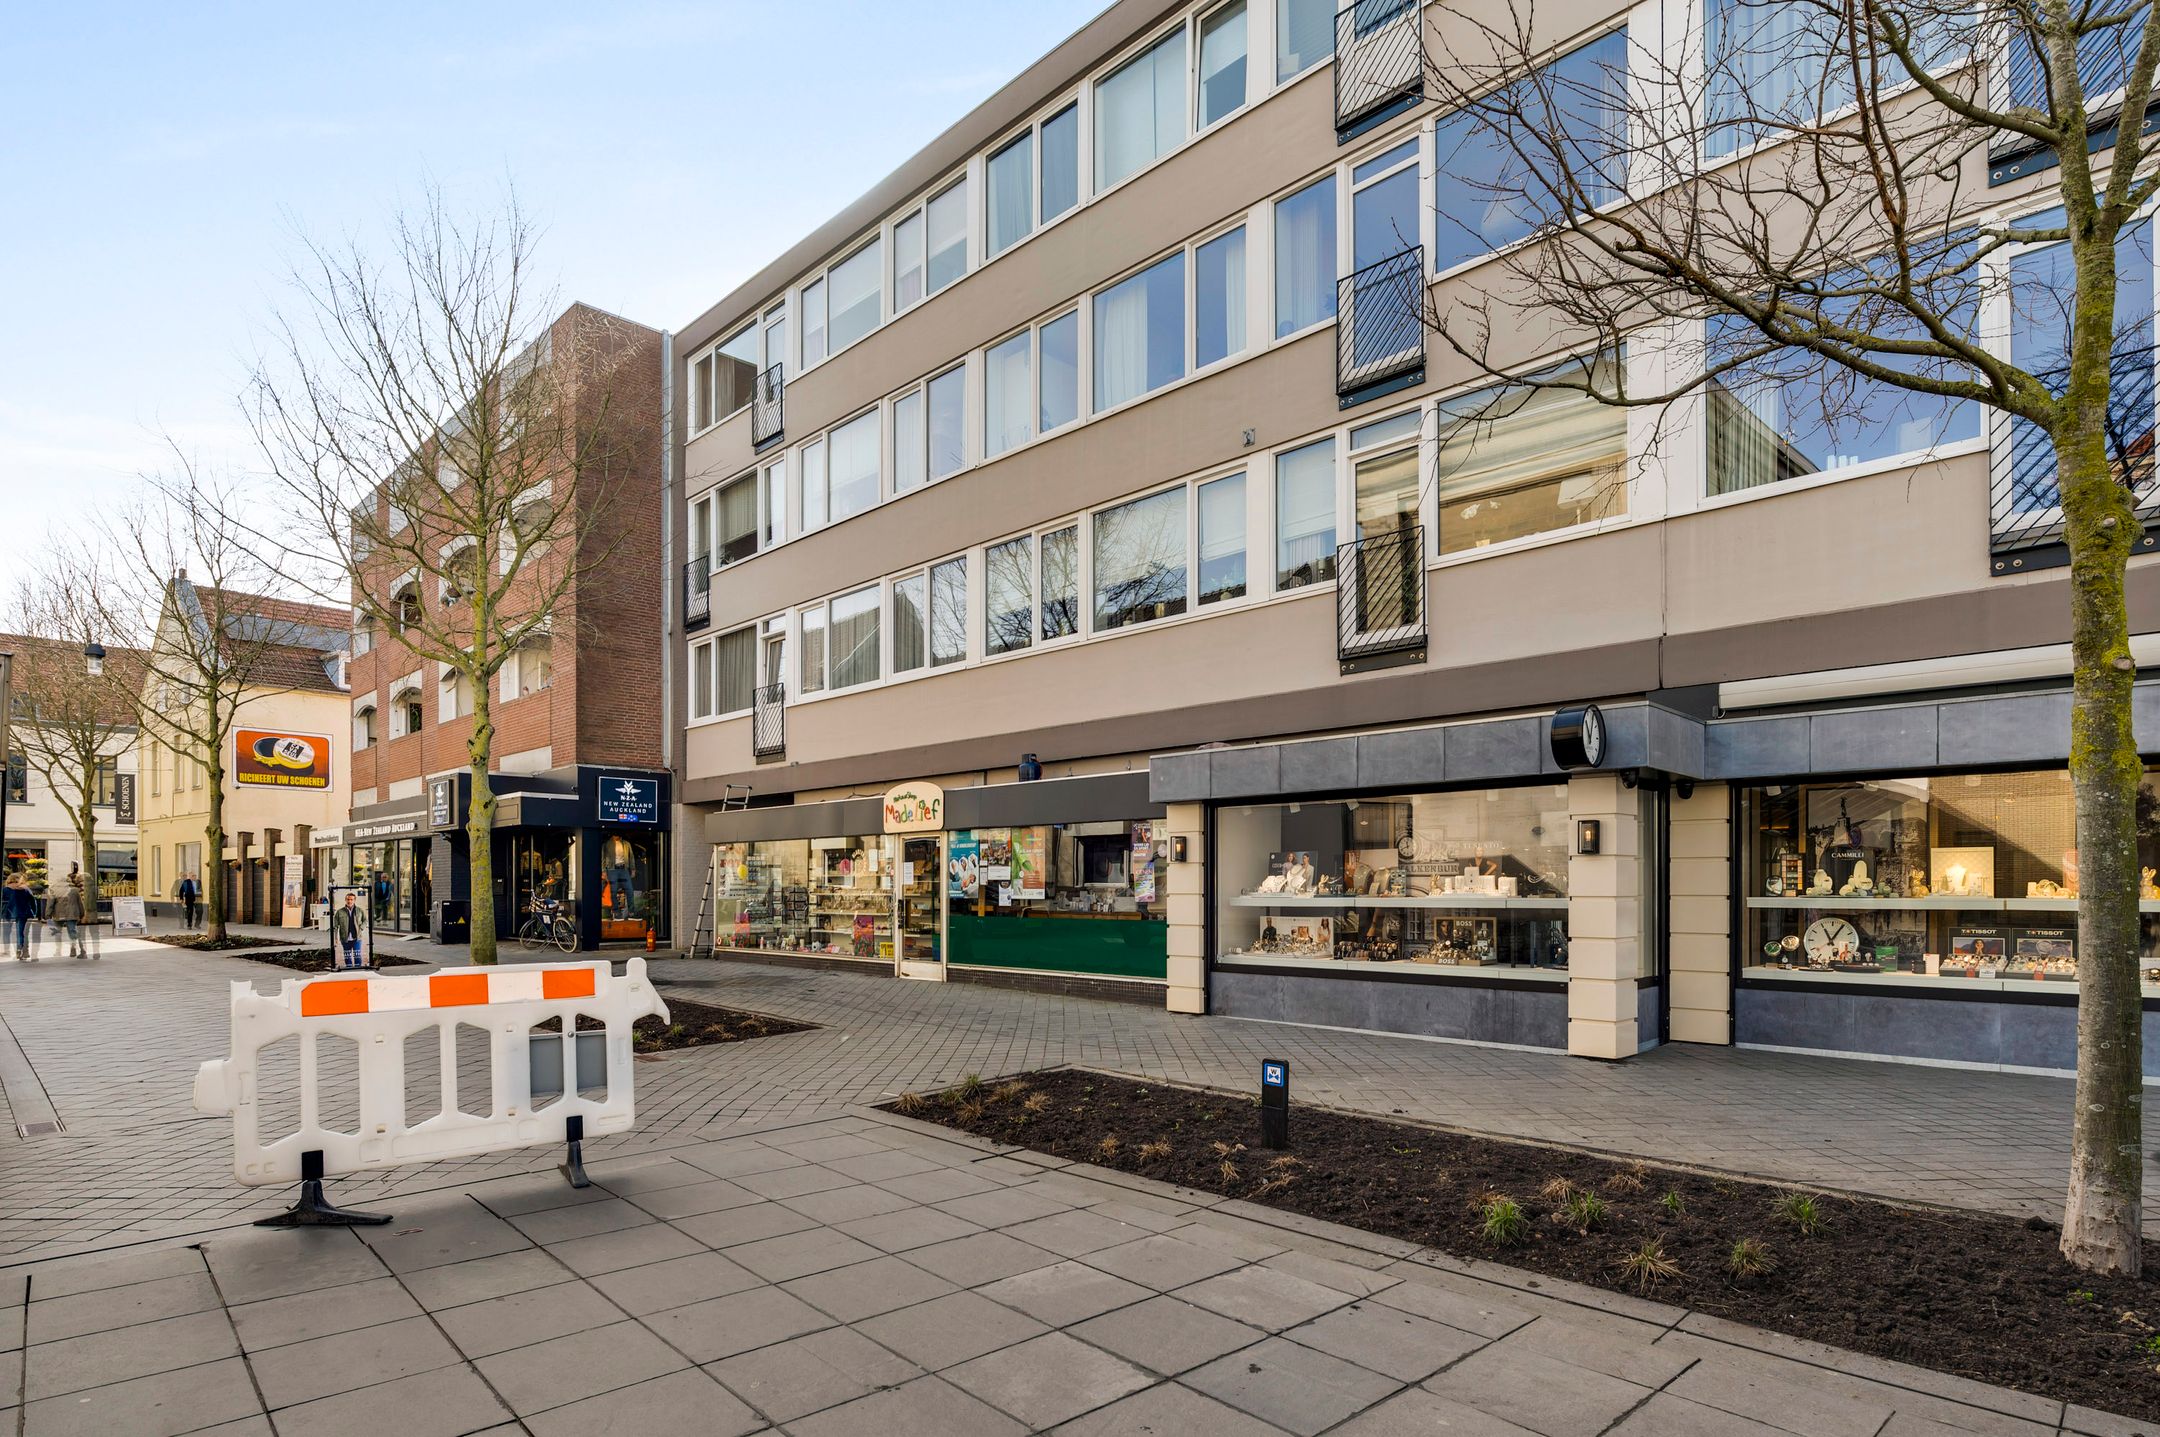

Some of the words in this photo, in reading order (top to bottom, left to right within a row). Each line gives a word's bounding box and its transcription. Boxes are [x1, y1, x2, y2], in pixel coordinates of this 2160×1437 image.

[277, 775, 289, 784] UW
[290, 775, 325, 787] SCHOENEN
[121, 776, 130, 810] SCHOENEN
